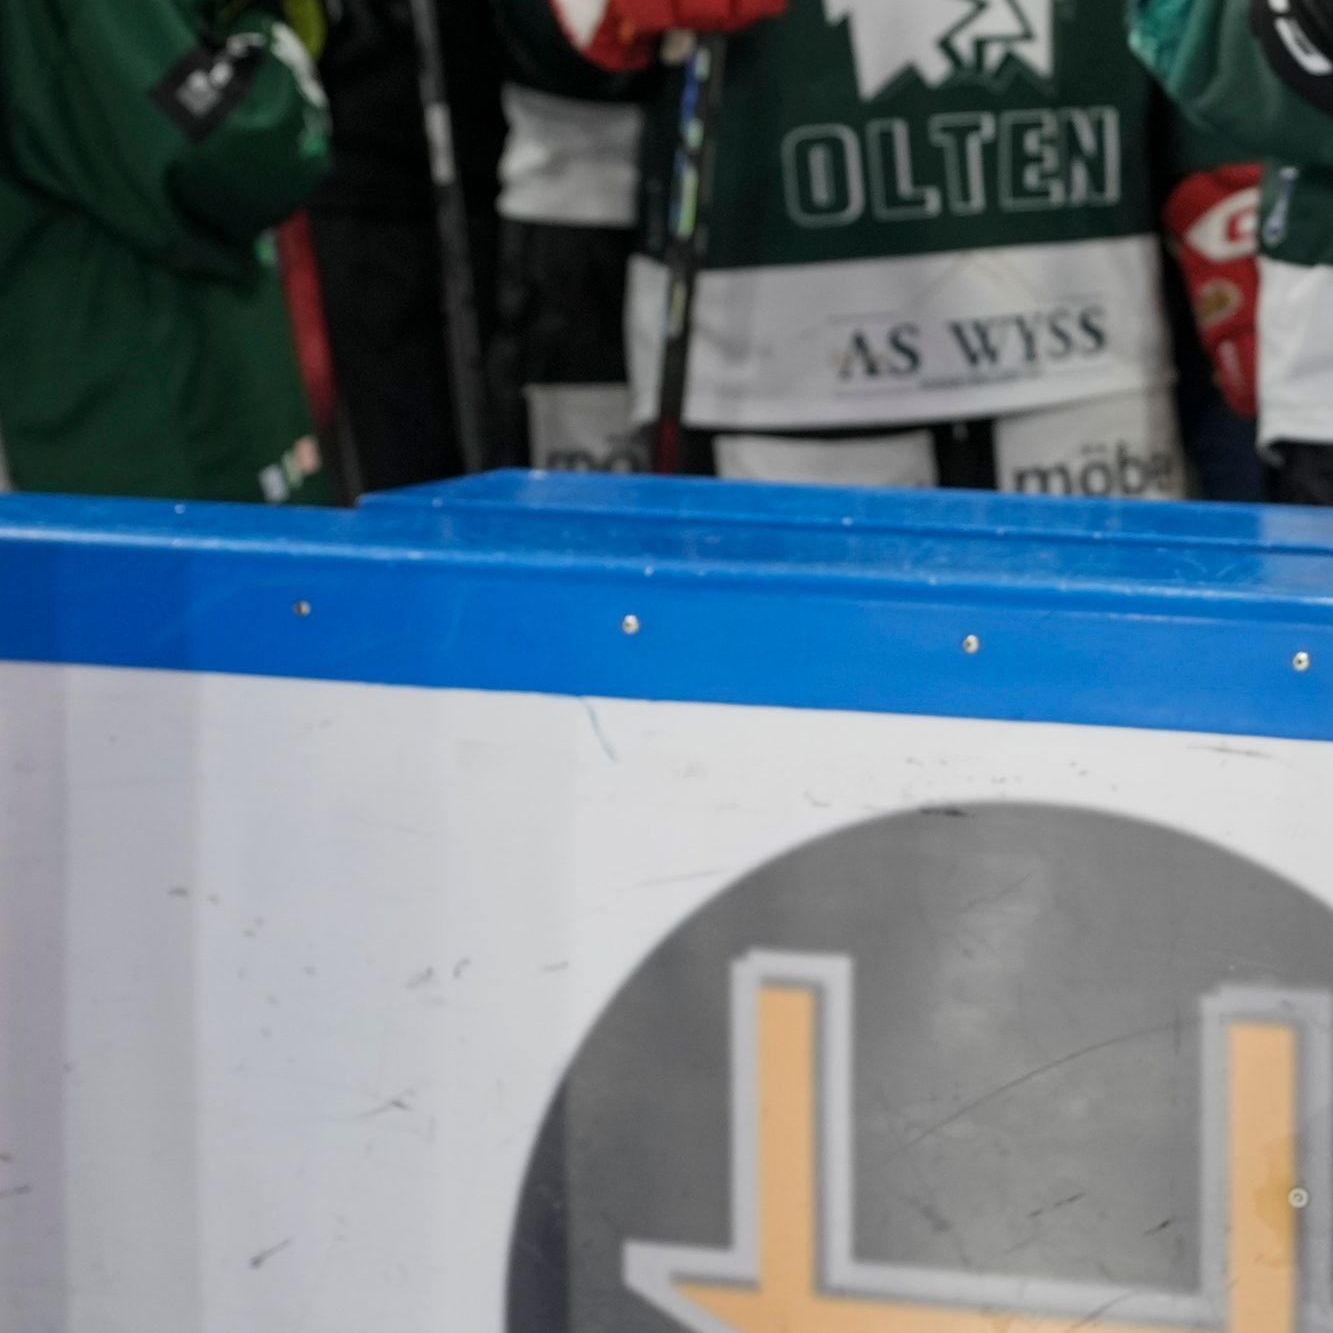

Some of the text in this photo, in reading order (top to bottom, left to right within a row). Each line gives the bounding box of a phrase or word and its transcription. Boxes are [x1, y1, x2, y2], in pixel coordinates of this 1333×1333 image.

[780, 106, 1122, 227] OLTEN
[836, 307, 1107, 379] AS WYSS
